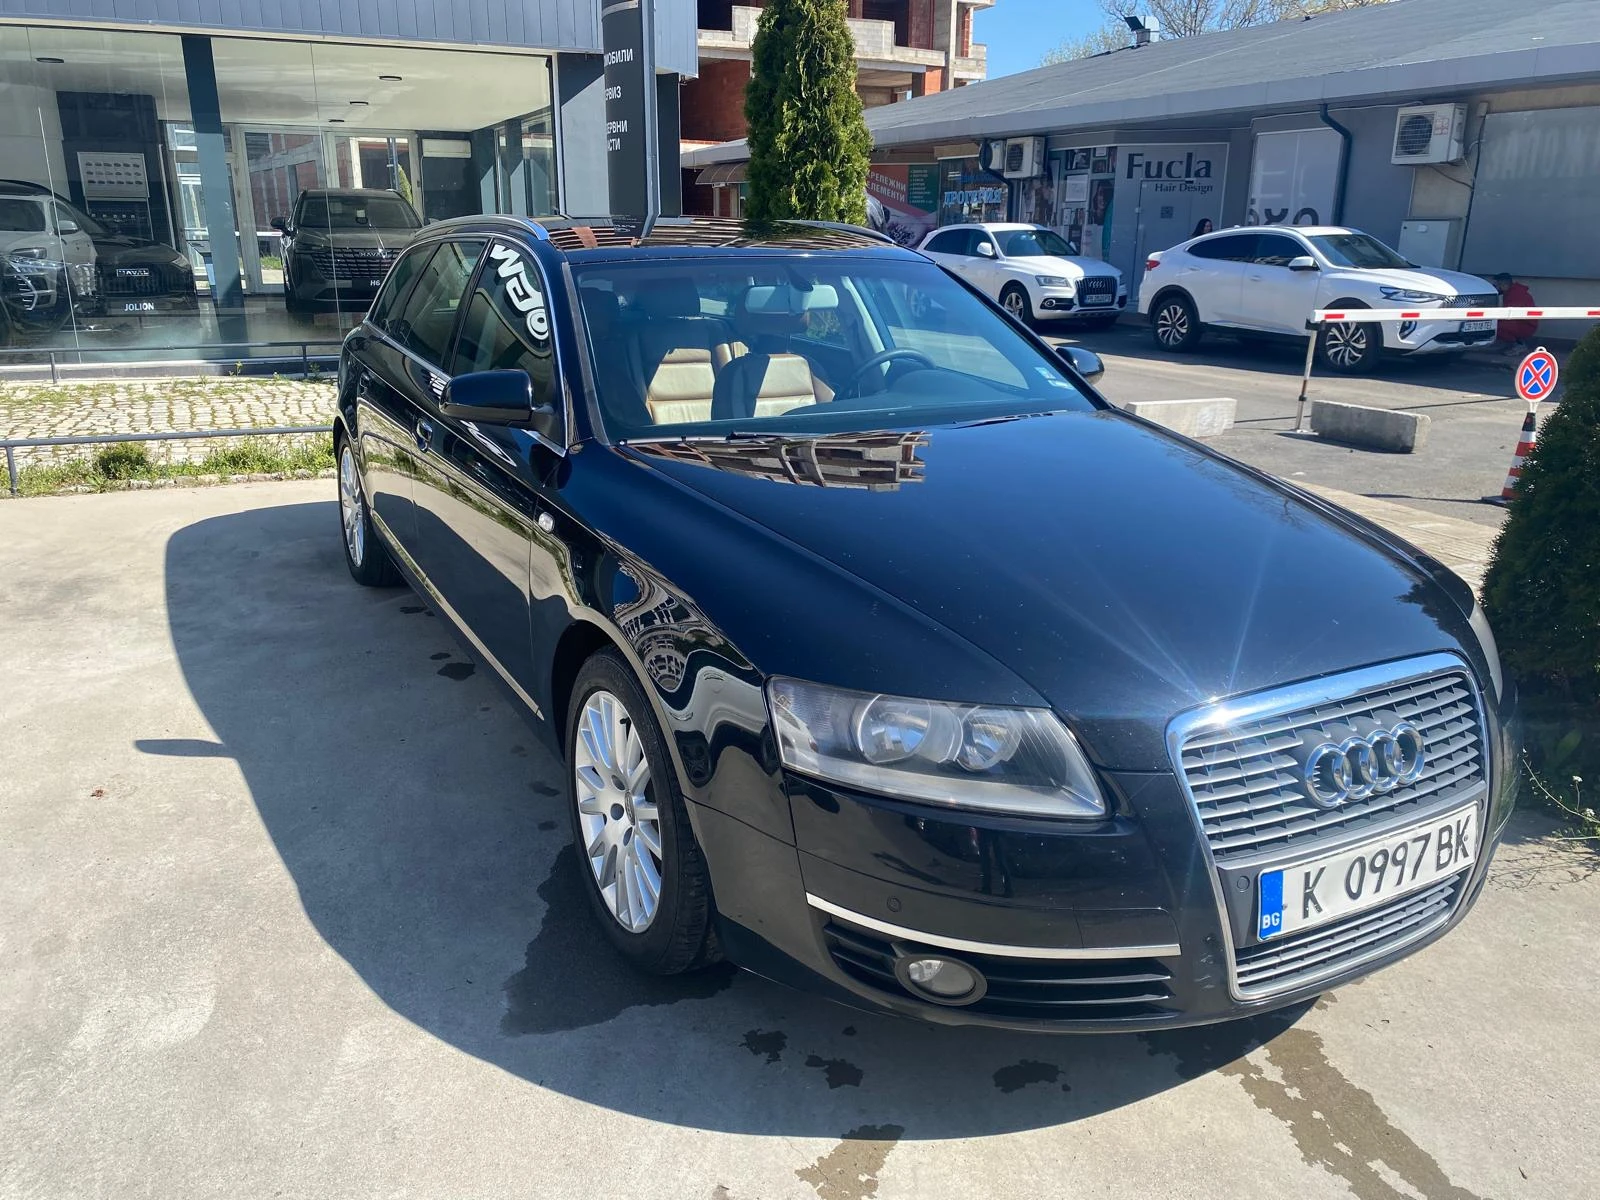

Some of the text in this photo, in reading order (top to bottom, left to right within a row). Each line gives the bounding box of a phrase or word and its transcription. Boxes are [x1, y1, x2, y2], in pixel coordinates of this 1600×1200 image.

[1126, 152, 1212, 179] Fucla
[1155, 183, 1213, 194] Hair Design
[124, 303, 155, 311] JOLION
[1261, 912, 1281, 930] BG
